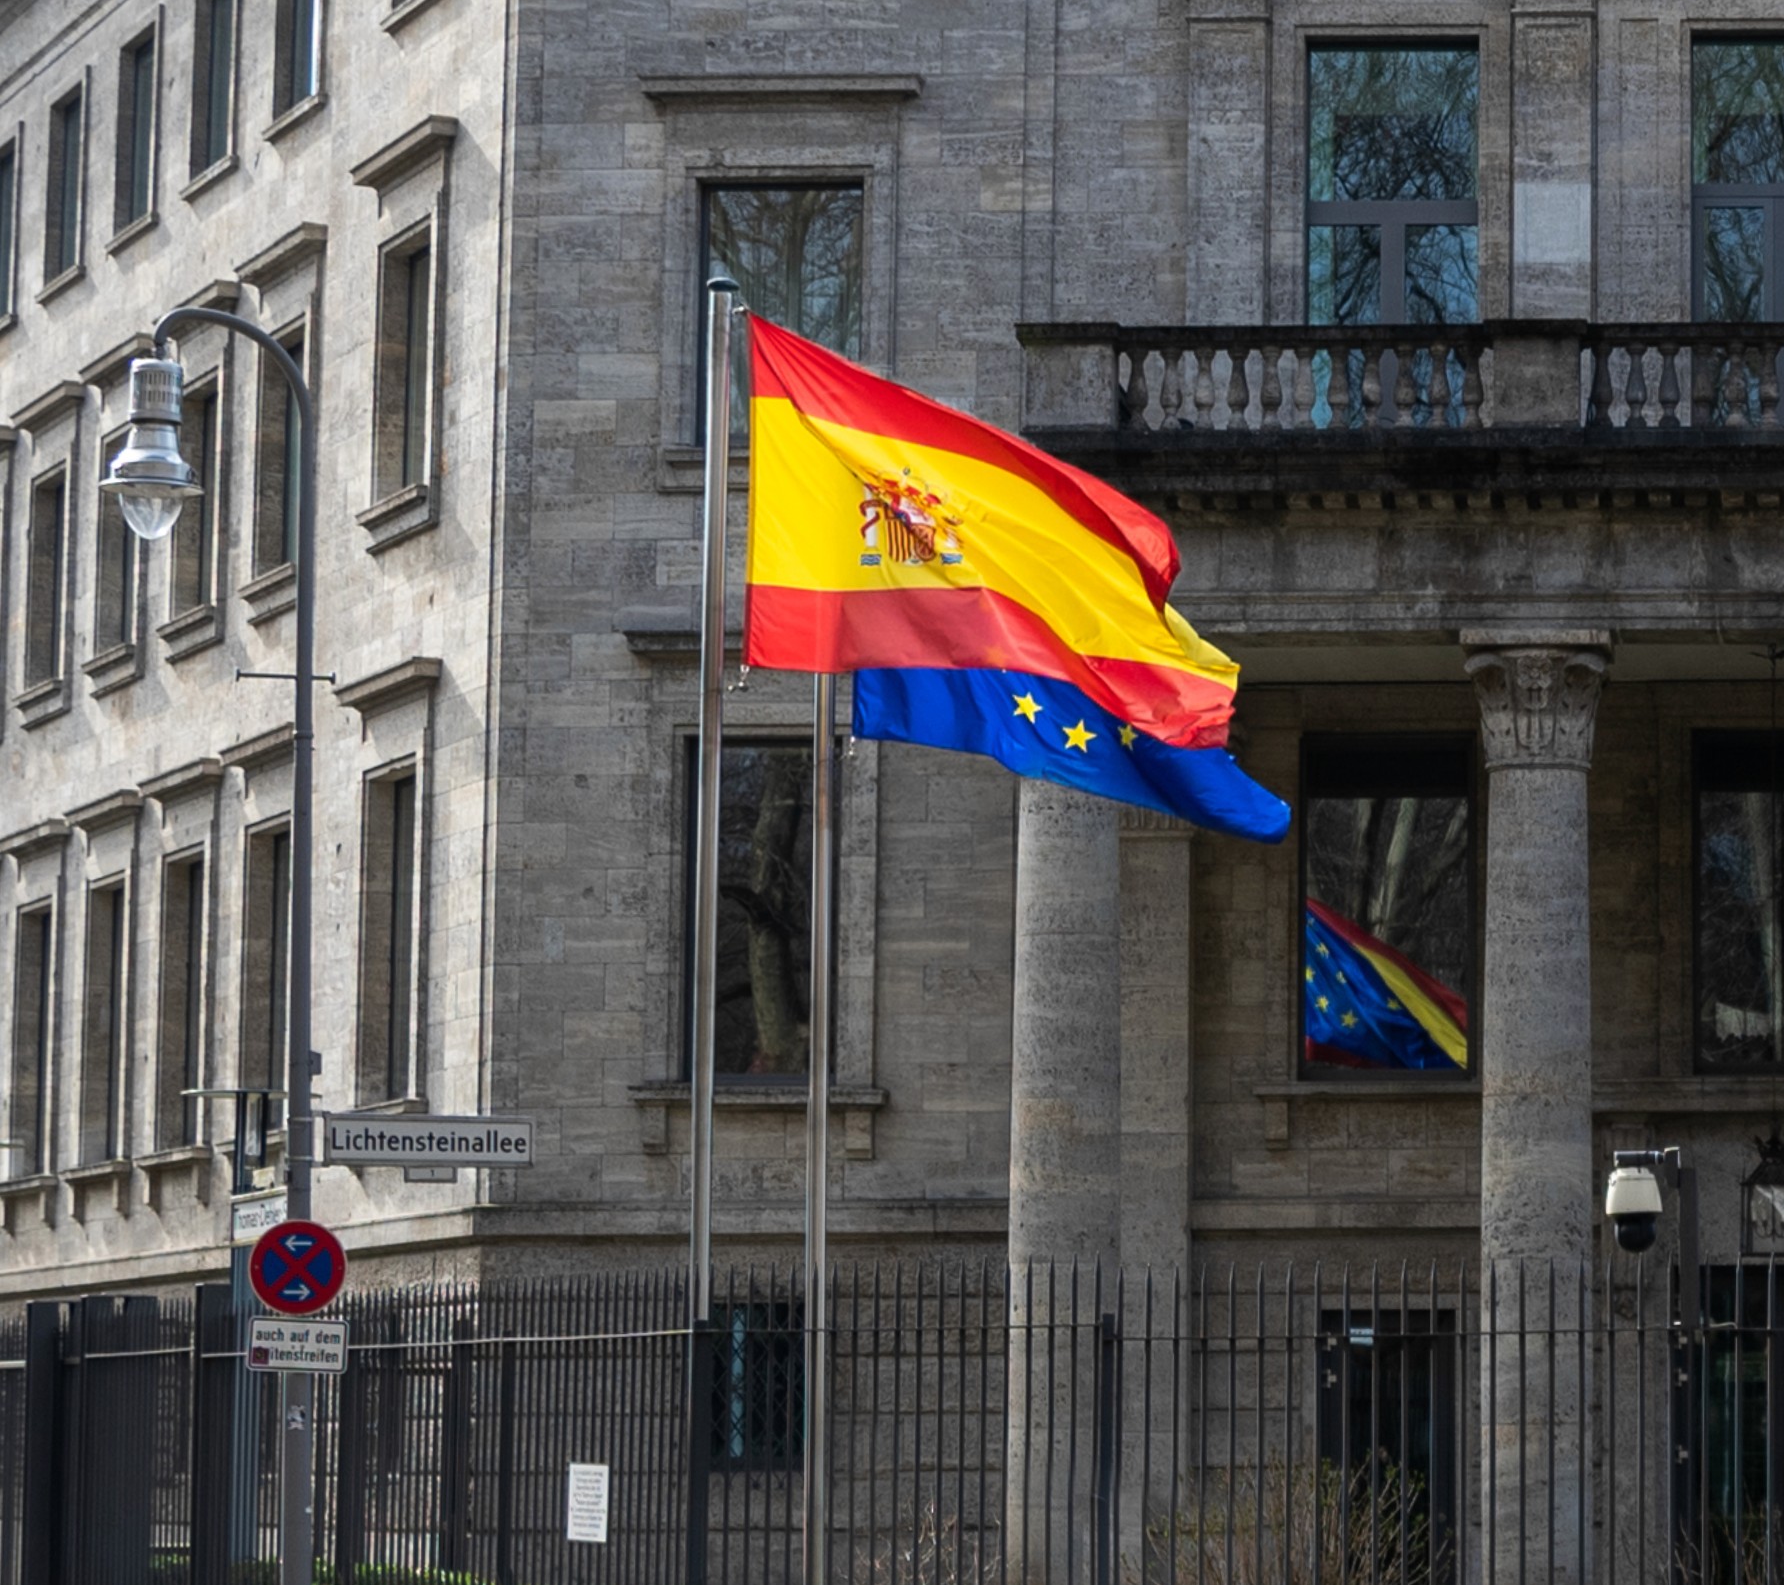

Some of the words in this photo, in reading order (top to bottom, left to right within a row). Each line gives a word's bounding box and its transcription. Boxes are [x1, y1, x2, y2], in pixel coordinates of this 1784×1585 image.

[331, 1127, 527, 1154] Lichtensteinallee
[256, 1327, 284, 1341] auch
[290, 1329, 310, 1343] auf
[315, 1329, 340, 1344] dem
[268, 1346, 339, 1363] itenstreifen
